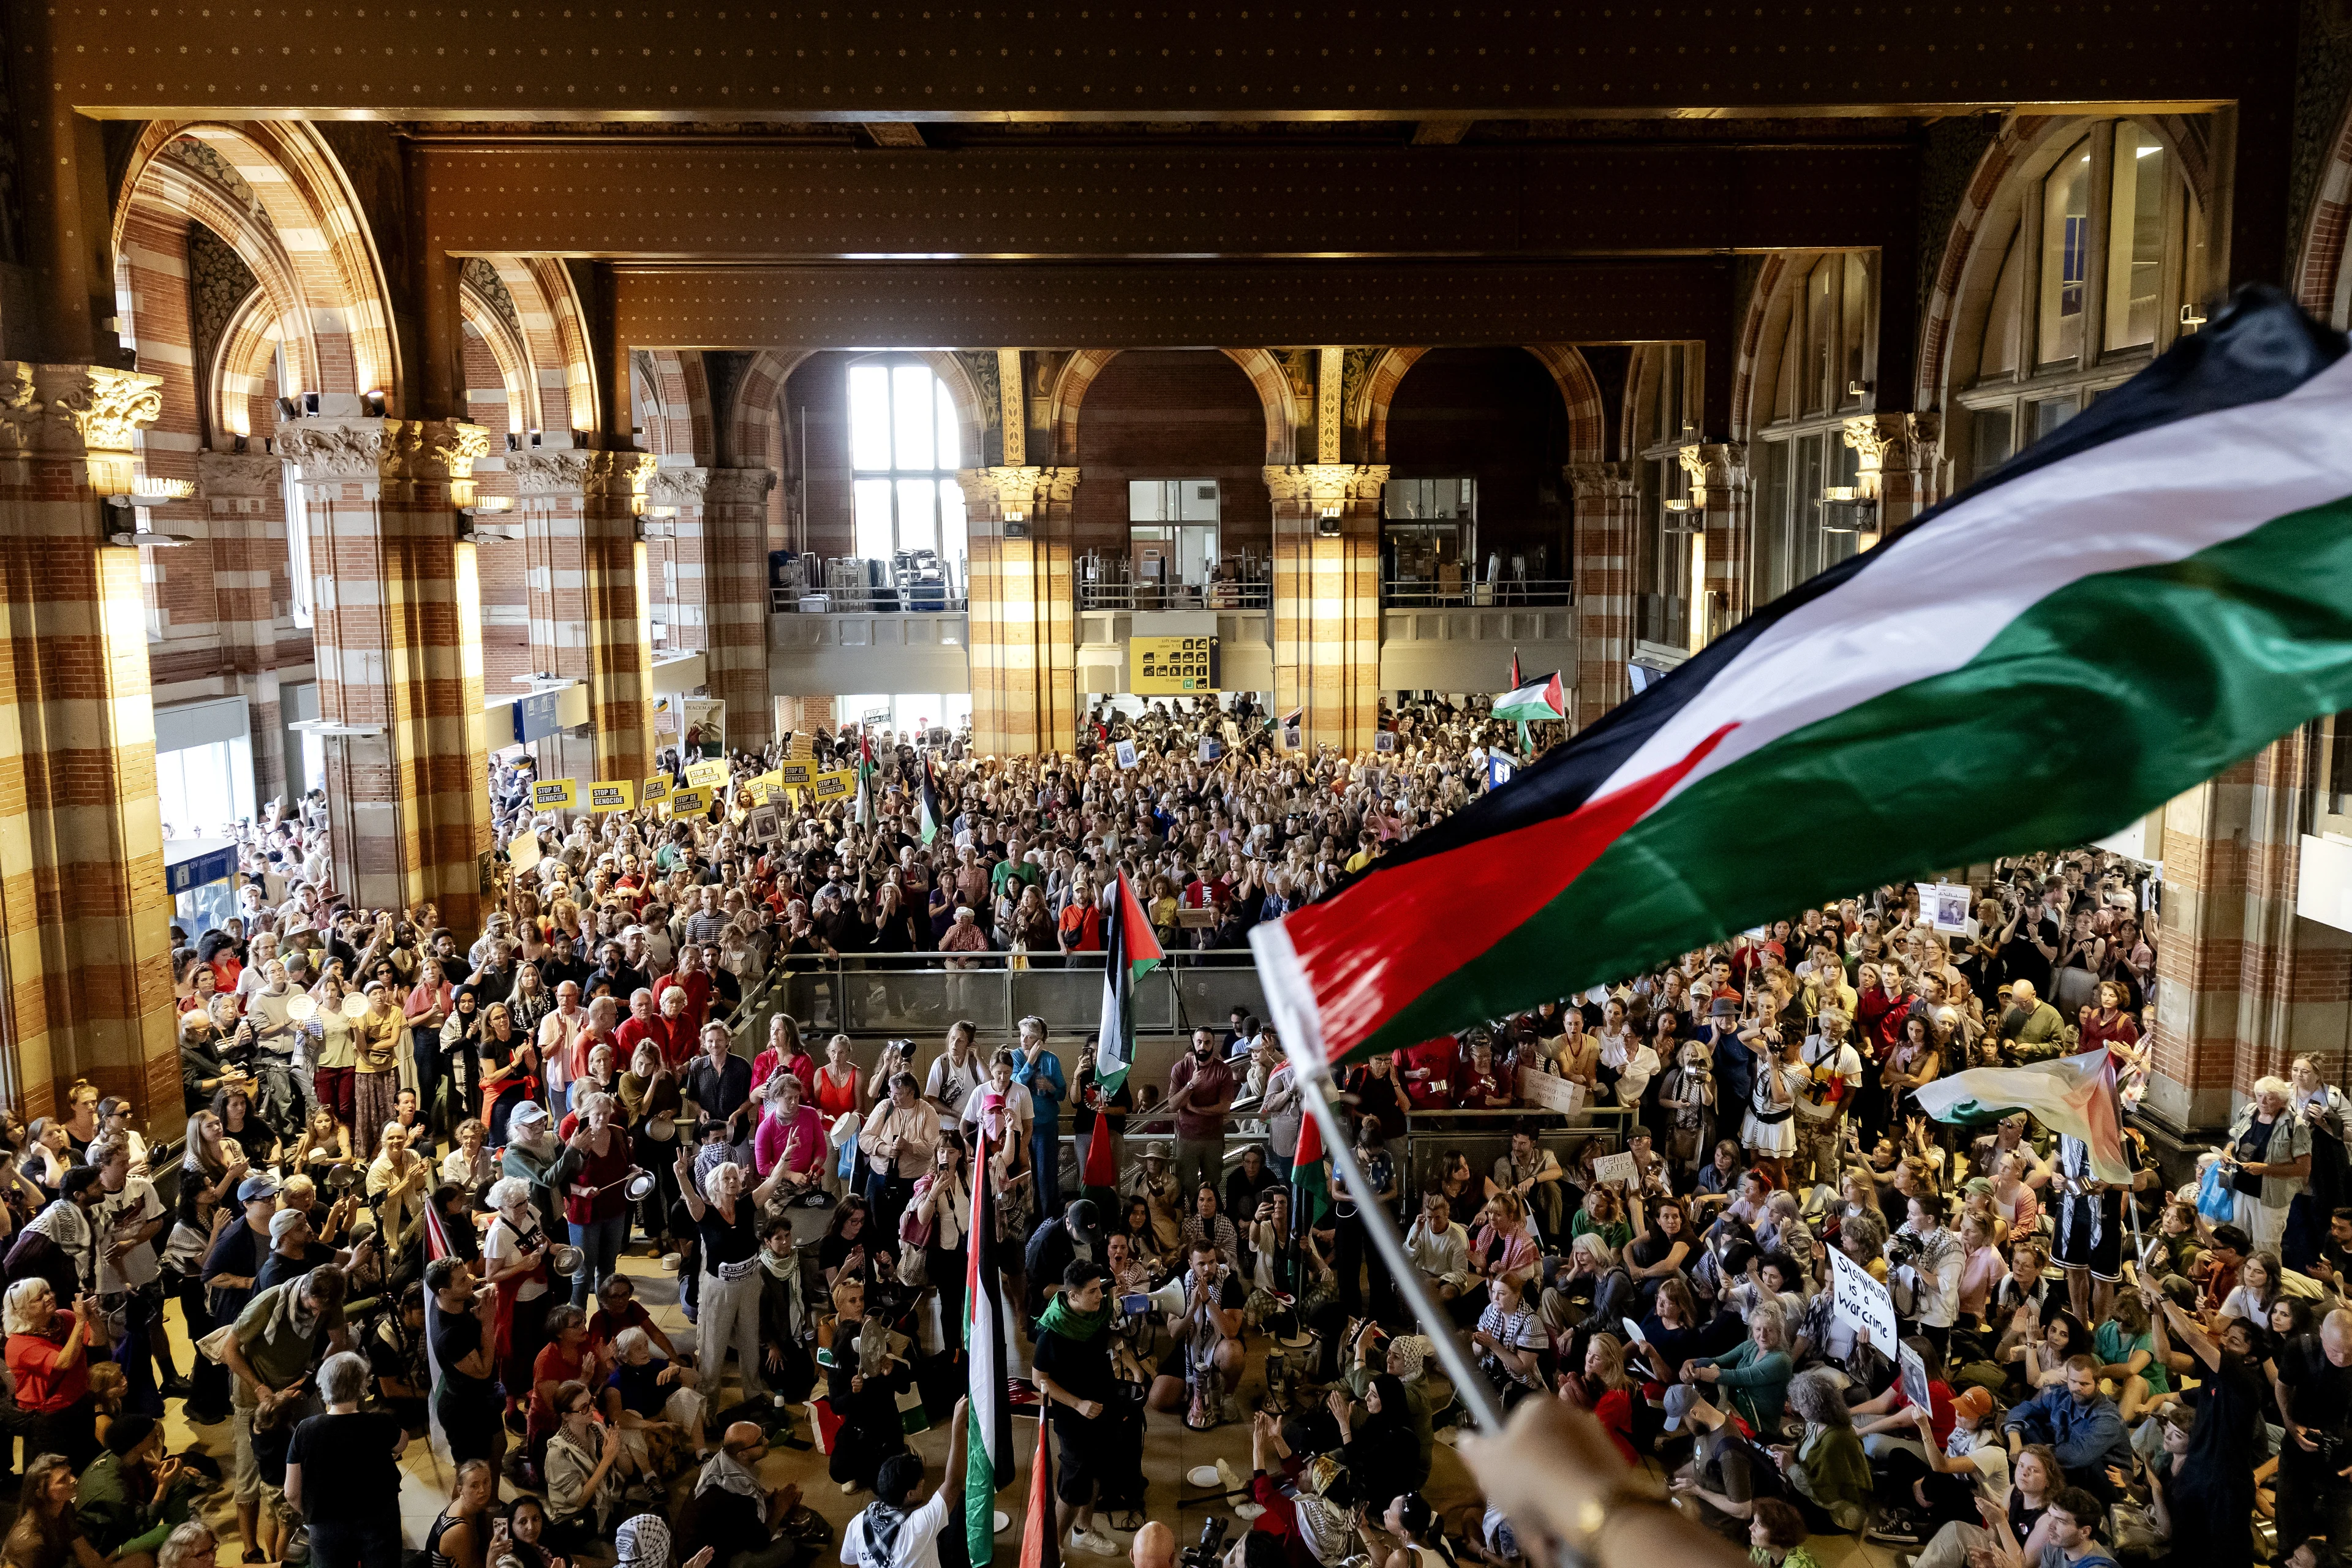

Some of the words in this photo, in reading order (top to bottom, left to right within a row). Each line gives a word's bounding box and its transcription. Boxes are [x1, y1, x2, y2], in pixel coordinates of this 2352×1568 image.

[693, 774, 720, 785] GENOCIDE
[750, 783, 763, 791] STOP
[819, 785, 845, 795] GENOCIDE
[538, 794, 567, 803] GENOCIDE
[646, 790, 665, 799] GENOCIDE
[676, 802, 701, 812] GENOCIDE
[200, 853, 226, 865] Informatie
[1605, 1161, 1633, 1174] GATES!
[805, 1196, 824, 1205] LUEN
[1838, 1256, 1892, 1311] Starvation
[1849, 1279, 1858, 1297] is
[1864, 1295, 1870, 1306] a
